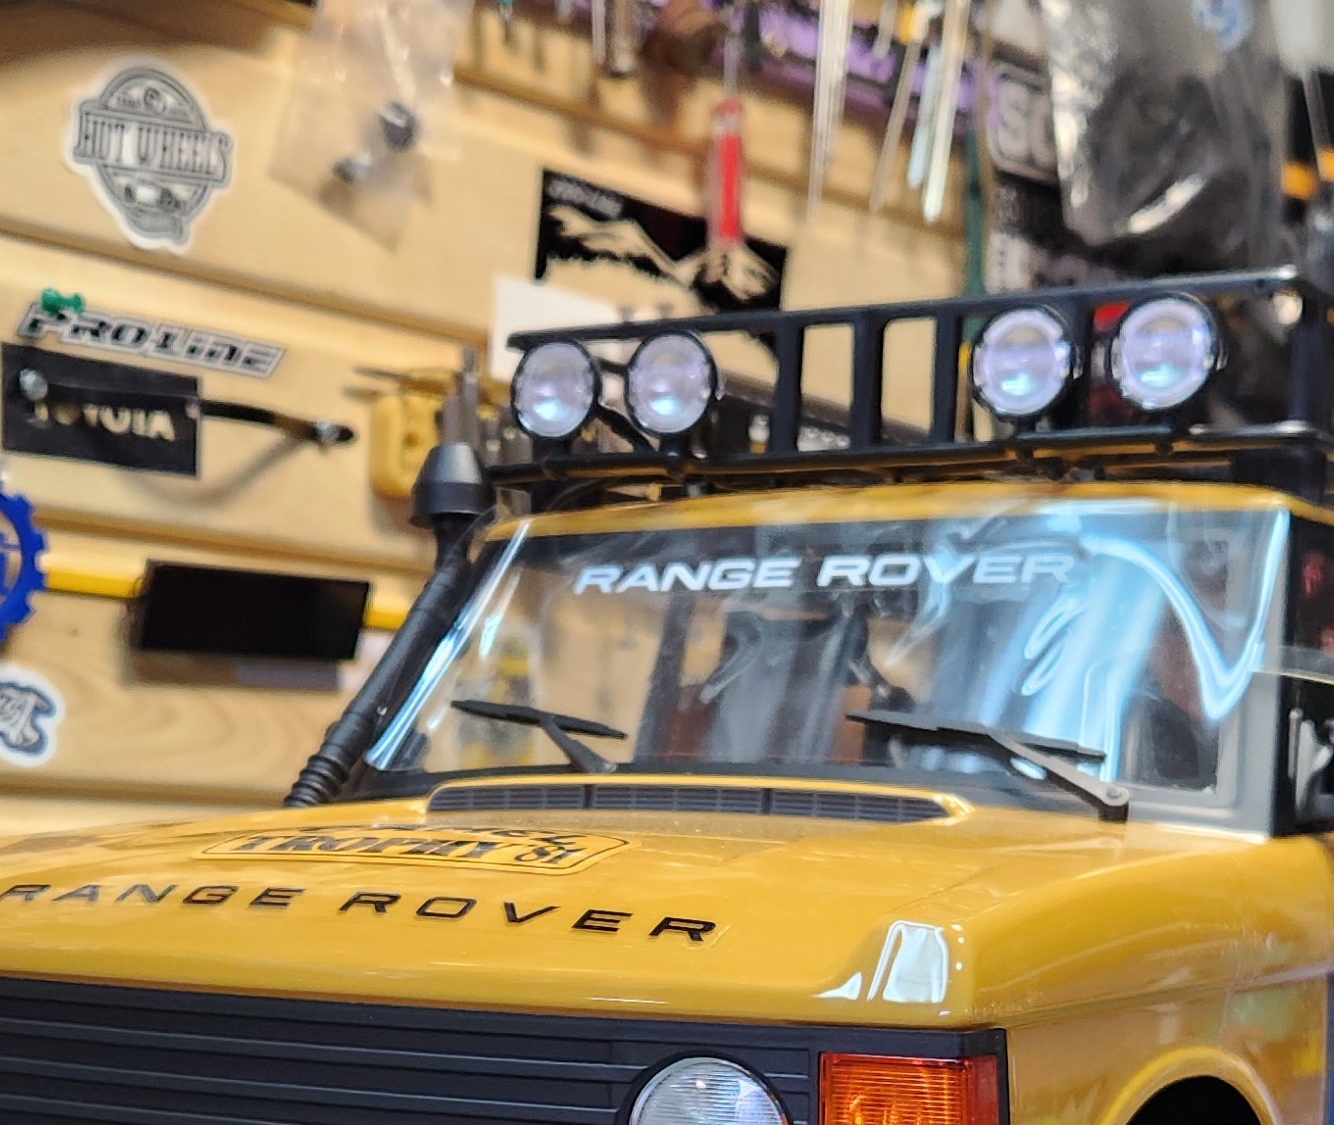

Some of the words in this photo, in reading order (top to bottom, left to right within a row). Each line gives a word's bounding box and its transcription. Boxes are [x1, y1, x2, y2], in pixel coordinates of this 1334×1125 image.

[133, 122, 233, 183] WHEELS
[572, 556, 802, 595] RANGE
[816, 552, 1076, 589] ROVER
[232, 835, 511, 858] TROPHY
[338, 891, 717, 943] ROVER
